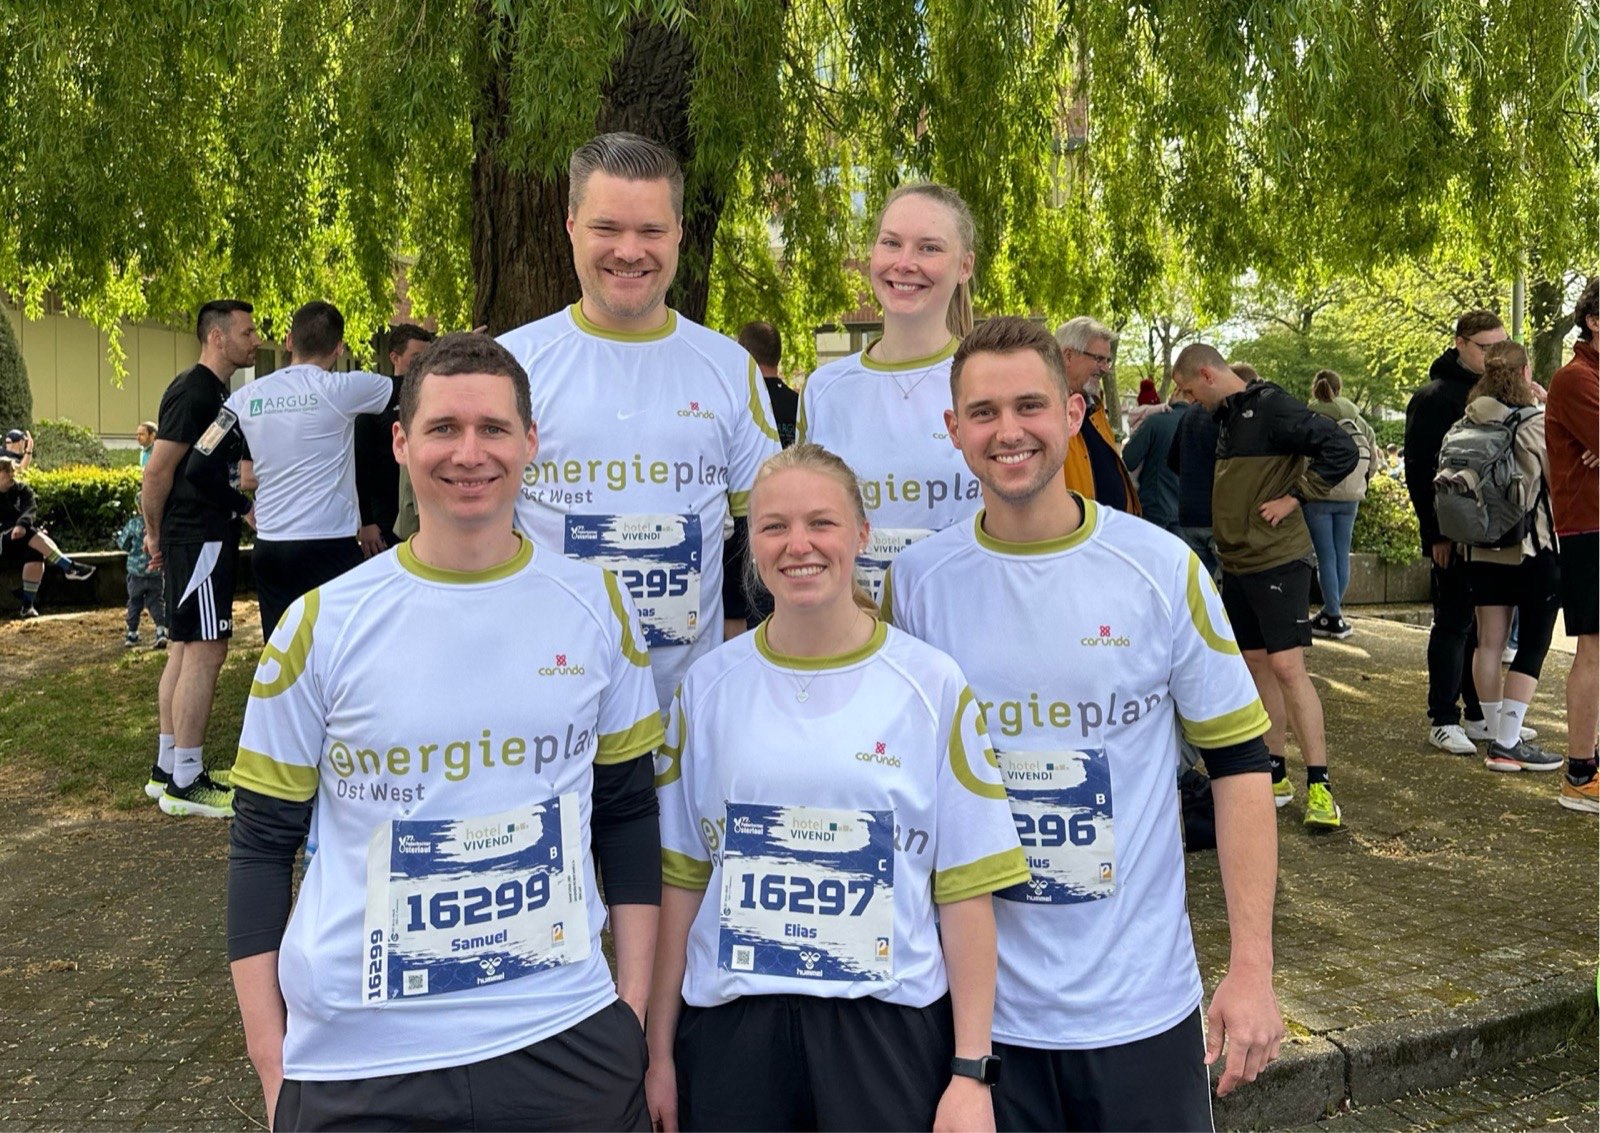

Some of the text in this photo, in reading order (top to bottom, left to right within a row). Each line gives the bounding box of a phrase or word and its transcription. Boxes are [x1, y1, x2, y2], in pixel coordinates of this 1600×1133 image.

[264, 393, 318, 409] ARGUS
[677, 409, 715, 420] carunda
[522, 453, 729, 493] energieplan
[550, 489, 593, 504] West
[862, 472, 983, 511] giepla
[623, 522, 652, 532] hotel
[621, 532, 661, 541] VIVENDI
[875, 535, 901, 545] hotel
[690, 551, 698, 562] C
[612, 568, 689, 599] 295
[1080, 636, 1131, 648] carunda
[538, 664, 585, 677] carunda
[855, 750, 902, 769] carunda
[1008, 760, 1041, 771] hotel
[1007, 771, 1053, 781] VIVENDI
[336, 778, 426, 803] Ost West
[1095, 793, 1106, 805] B
[792, 816, 824, 830] hotel
[465, 823, 502, 840] hotel
[790, 829, 836, 842] VIVENDI
[463, 834, 515, 851] VIVENDI
[549, 846, 559, 860] B
[877, 858, 888, 872] C
[407, 870, 551, 933] 16299
[740, 872, 876, 917] 16297
[1026, 893, 1053, 902] hummel
[784, 922, 818, 939] Elias
[451, 929, 508, 952] Samuel
[368, 928, 384, 1001] 16299
[476, 971, 506, 985] hummel
[796, 967, 824, 978] hummel
